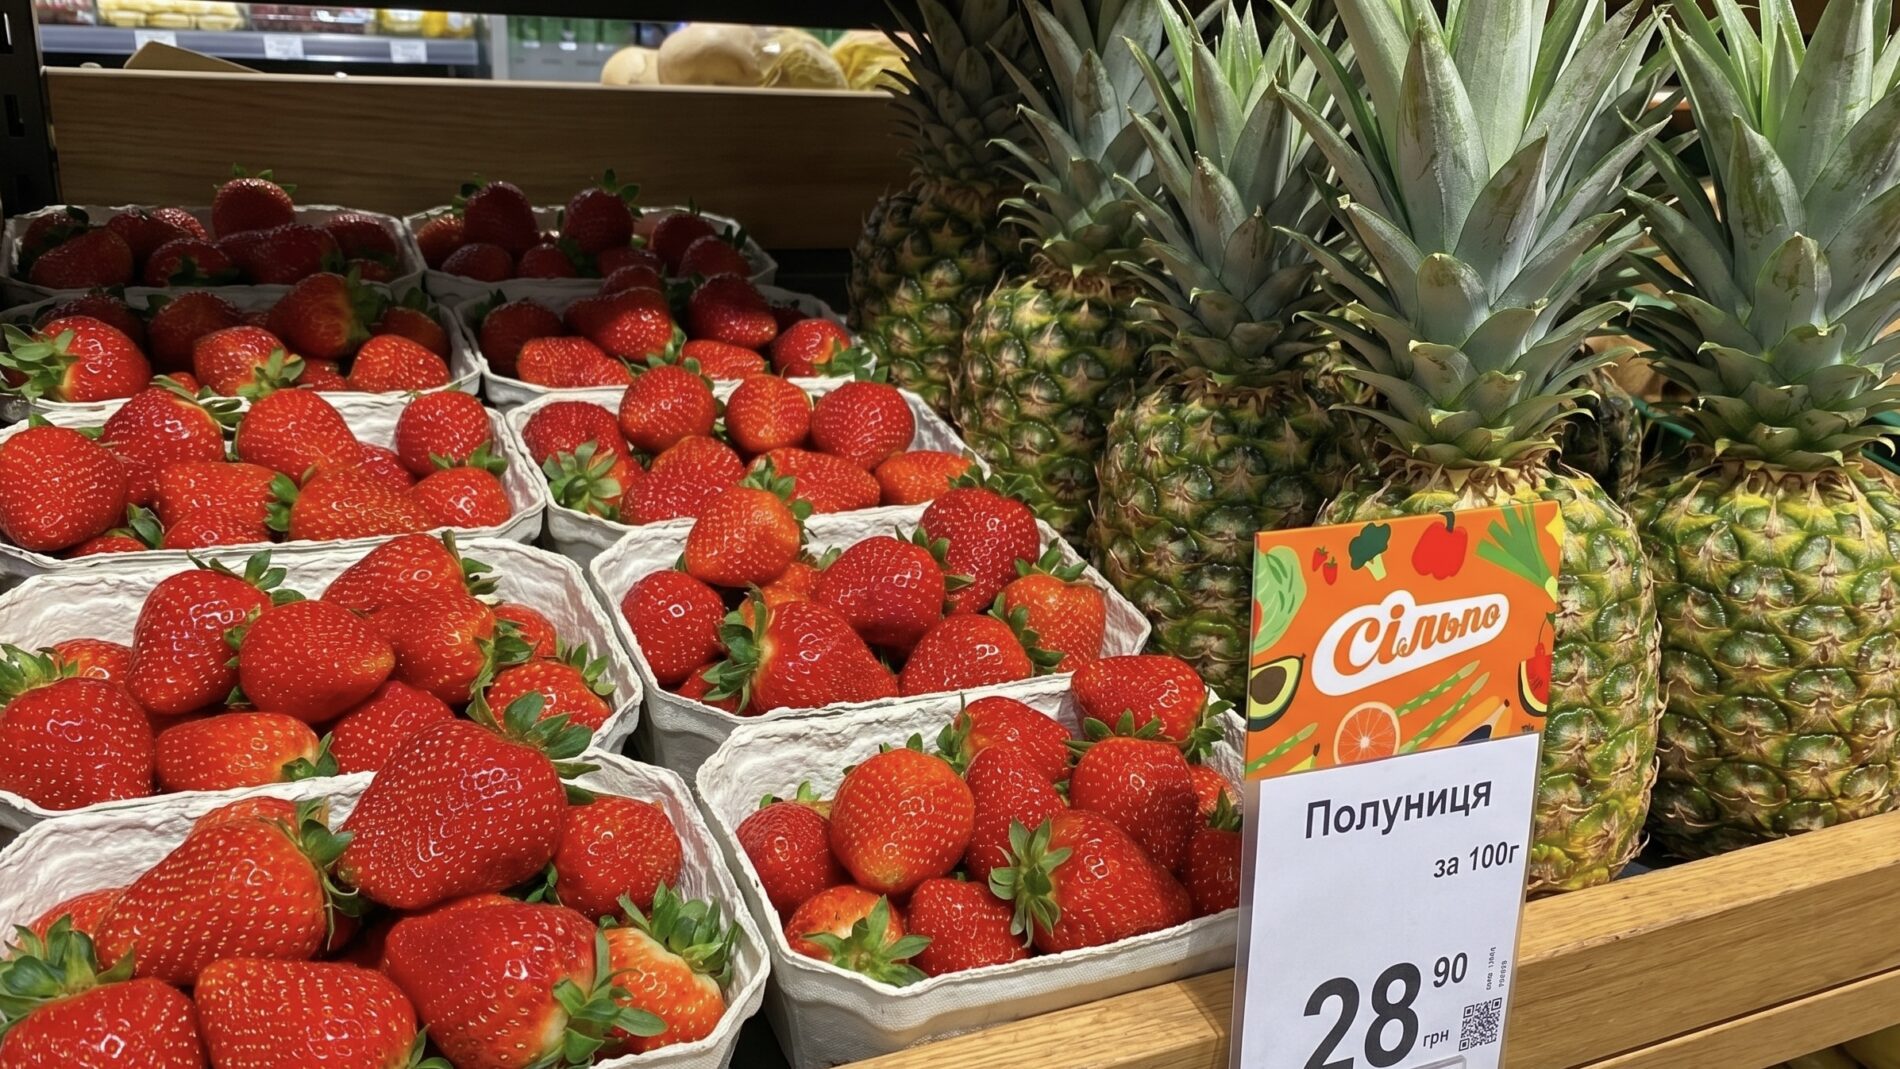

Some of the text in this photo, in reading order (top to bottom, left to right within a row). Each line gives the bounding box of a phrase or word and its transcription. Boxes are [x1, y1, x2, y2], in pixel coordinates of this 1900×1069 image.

[1333, 603, 1501, 678] Сільпо
[1304, 780, 1493, 839] Полуниця
[1433, 841, 1520, 878] за 100г
[1302, 962, 1422, 1069] 28
[1432, 952, 1469, 988] 90
[1422, 1029, 1450, 1049] грн
